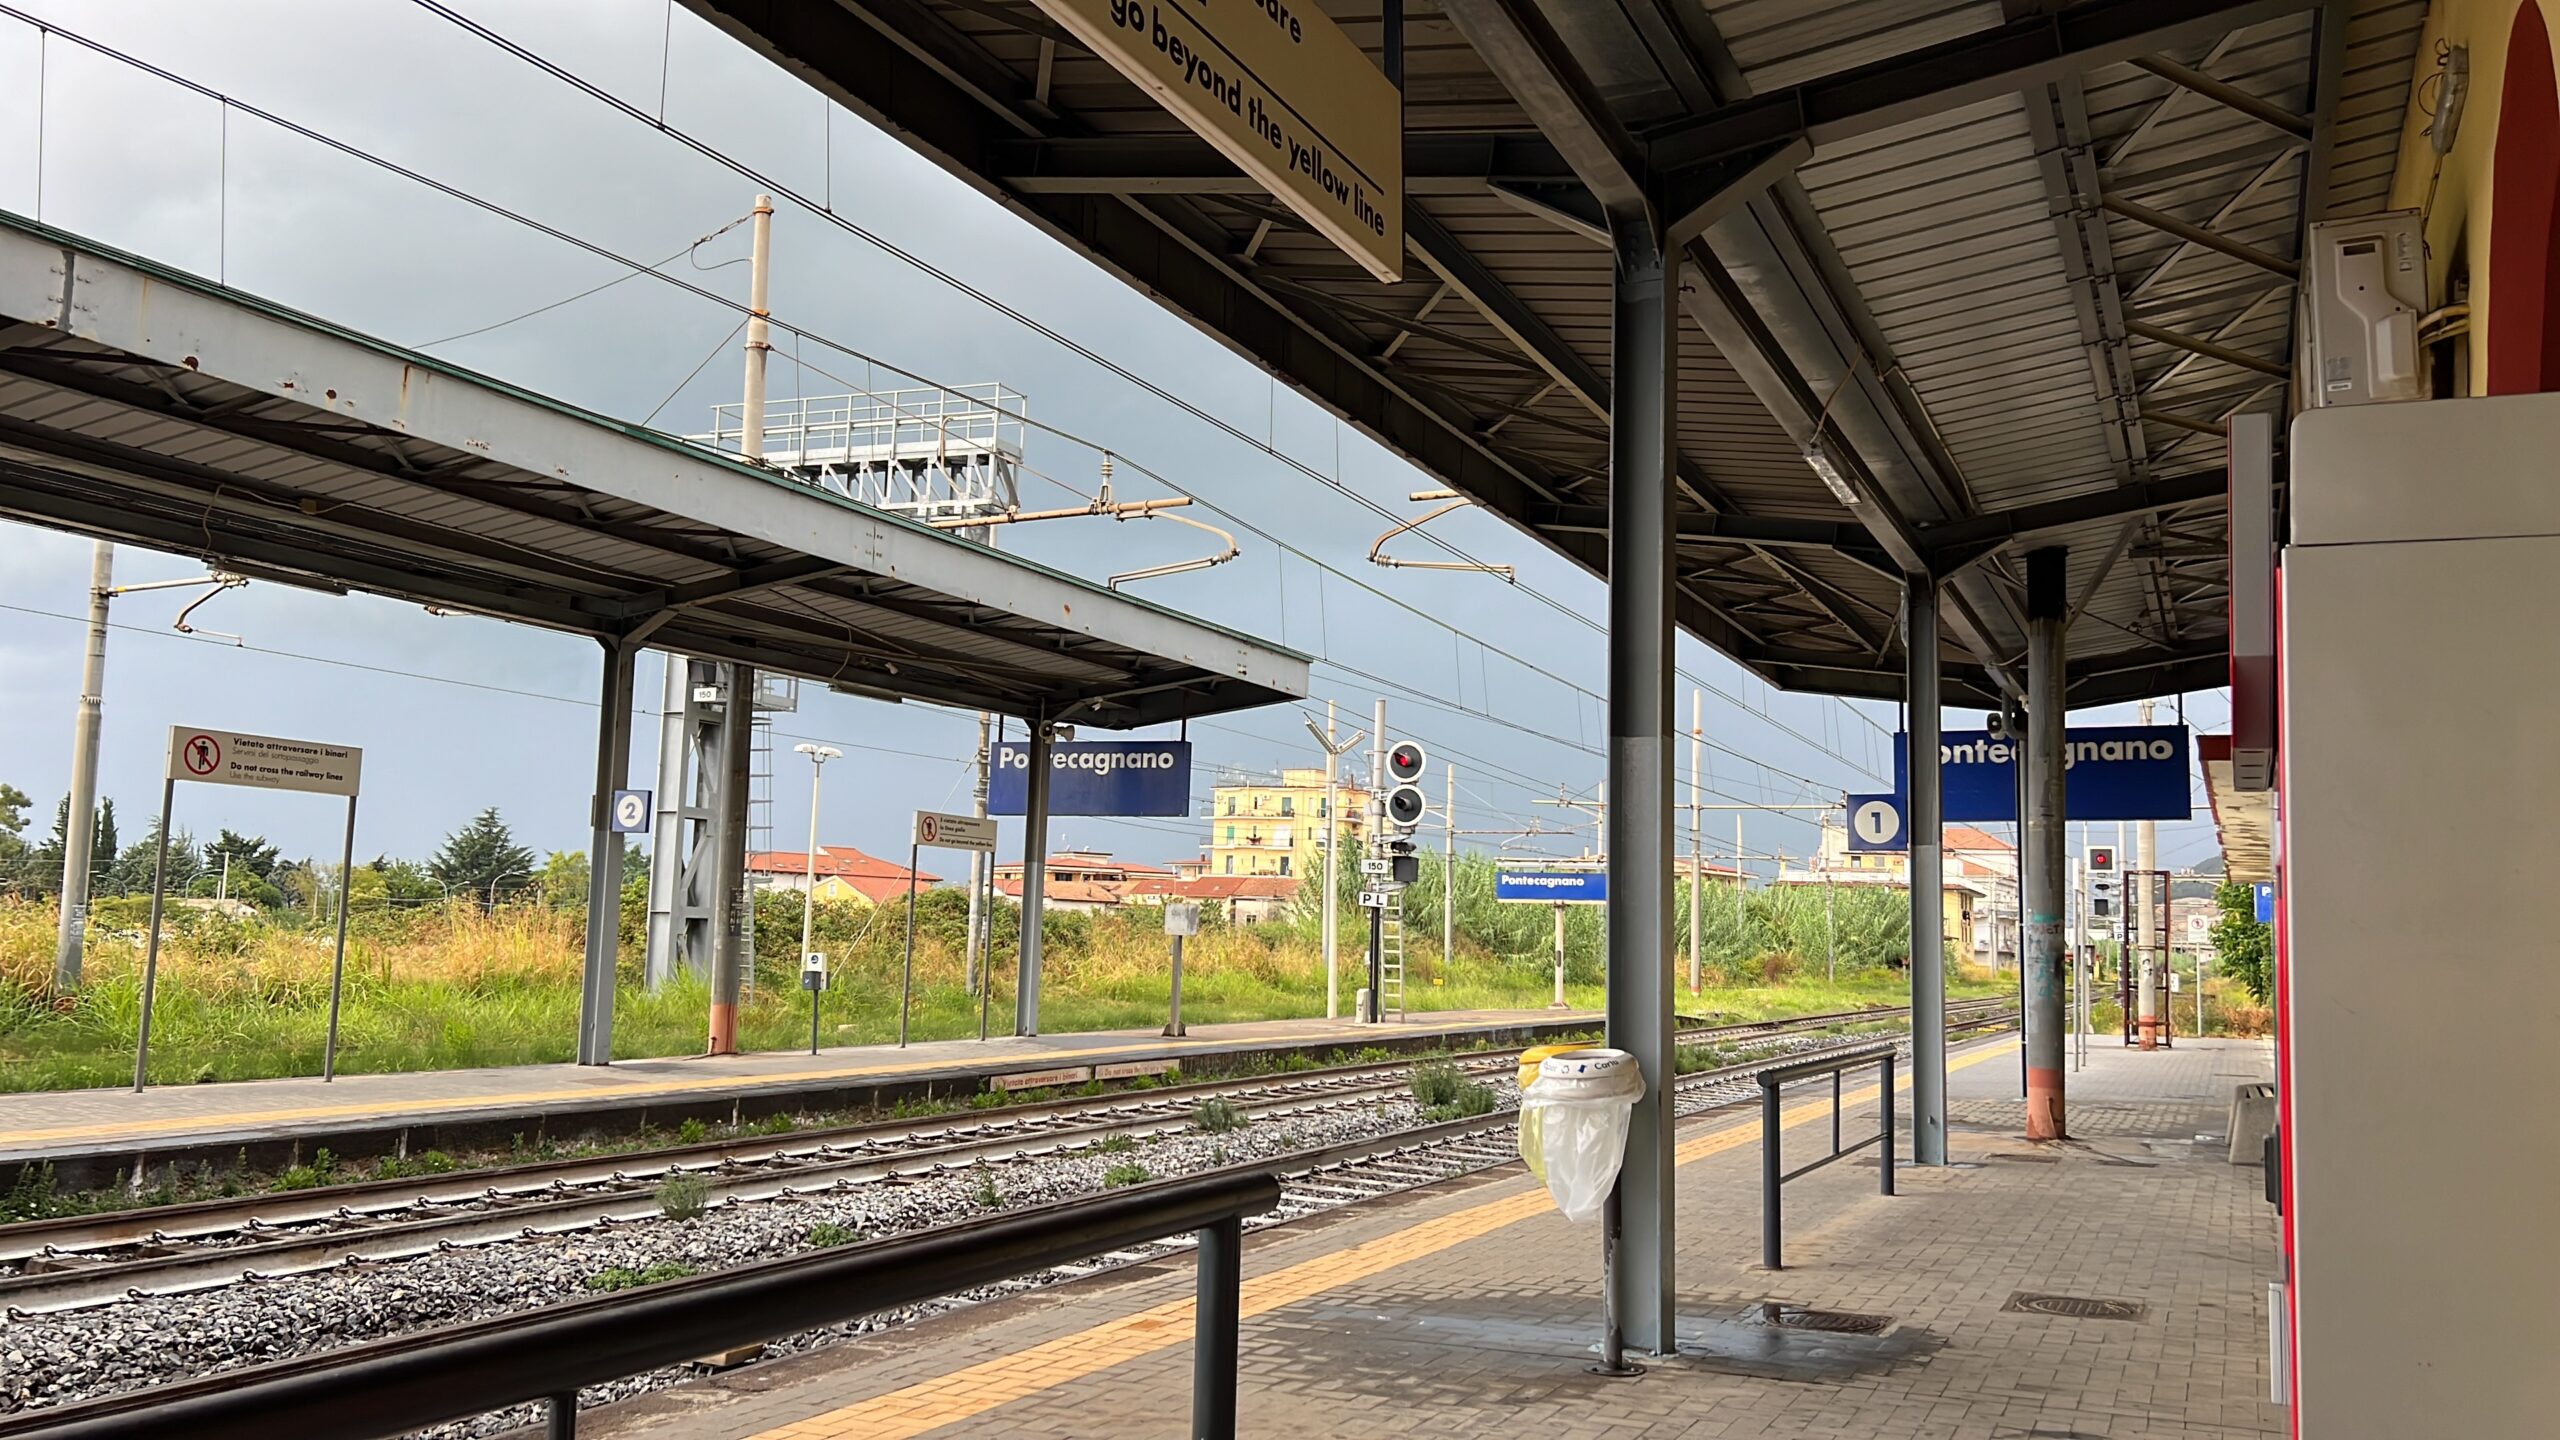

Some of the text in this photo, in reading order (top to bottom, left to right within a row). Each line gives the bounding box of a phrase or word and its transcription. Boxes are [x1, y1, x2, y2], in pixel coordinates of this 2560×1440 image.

[1110, 0, 1385, 237] go beyond the yellow line
[699, 690, 711, 699] 150
[233, 738, 348, 758] Vietato attraversare i binari
[1941, 739, 2174, 770] ntenano
[230, 761, 242, 770] Do
[259, 766, 279, 774] cross
[281, 766, 293, 775] the
[295, 769, 324, 780] railway
[326, 771, 343, 781] lines
[1000, 747, 1174, 775] Poecagnano
[625, 802, 636, 820] 2
[1871, 811, 1881, 834] 1
[1368, 862, 1383, 871] 150
[1501, 874, 1585, 888] Pontecagnano
